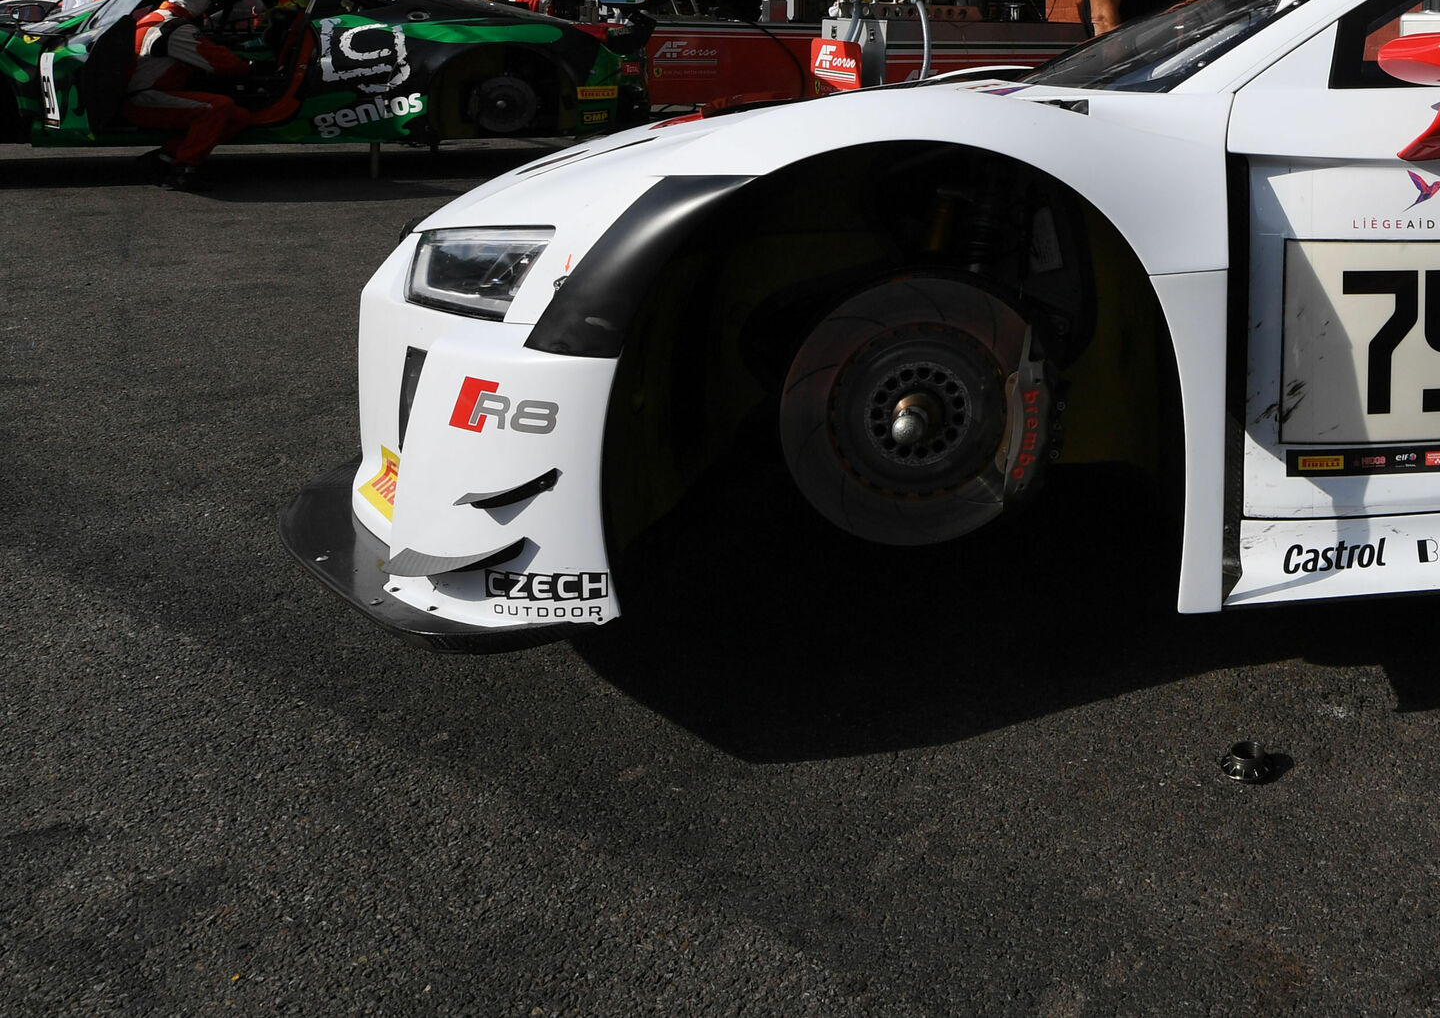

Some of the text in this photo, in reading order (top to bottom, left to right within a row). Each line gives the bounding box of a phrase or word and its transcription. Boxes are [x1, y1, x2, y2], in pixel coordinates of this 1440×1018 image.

[462, 390, 560, 435] R8
[1012, 389, 1040, 480] brembo
[1301, 457, 1341, 468] PIRELLI
[1395, 453, 1409, 462] elf
[1282, 536, 1387, 575] Castrol
[488, 572, 609, 601] CZECH
[493, 603, 603, 619] OUTDOOR
